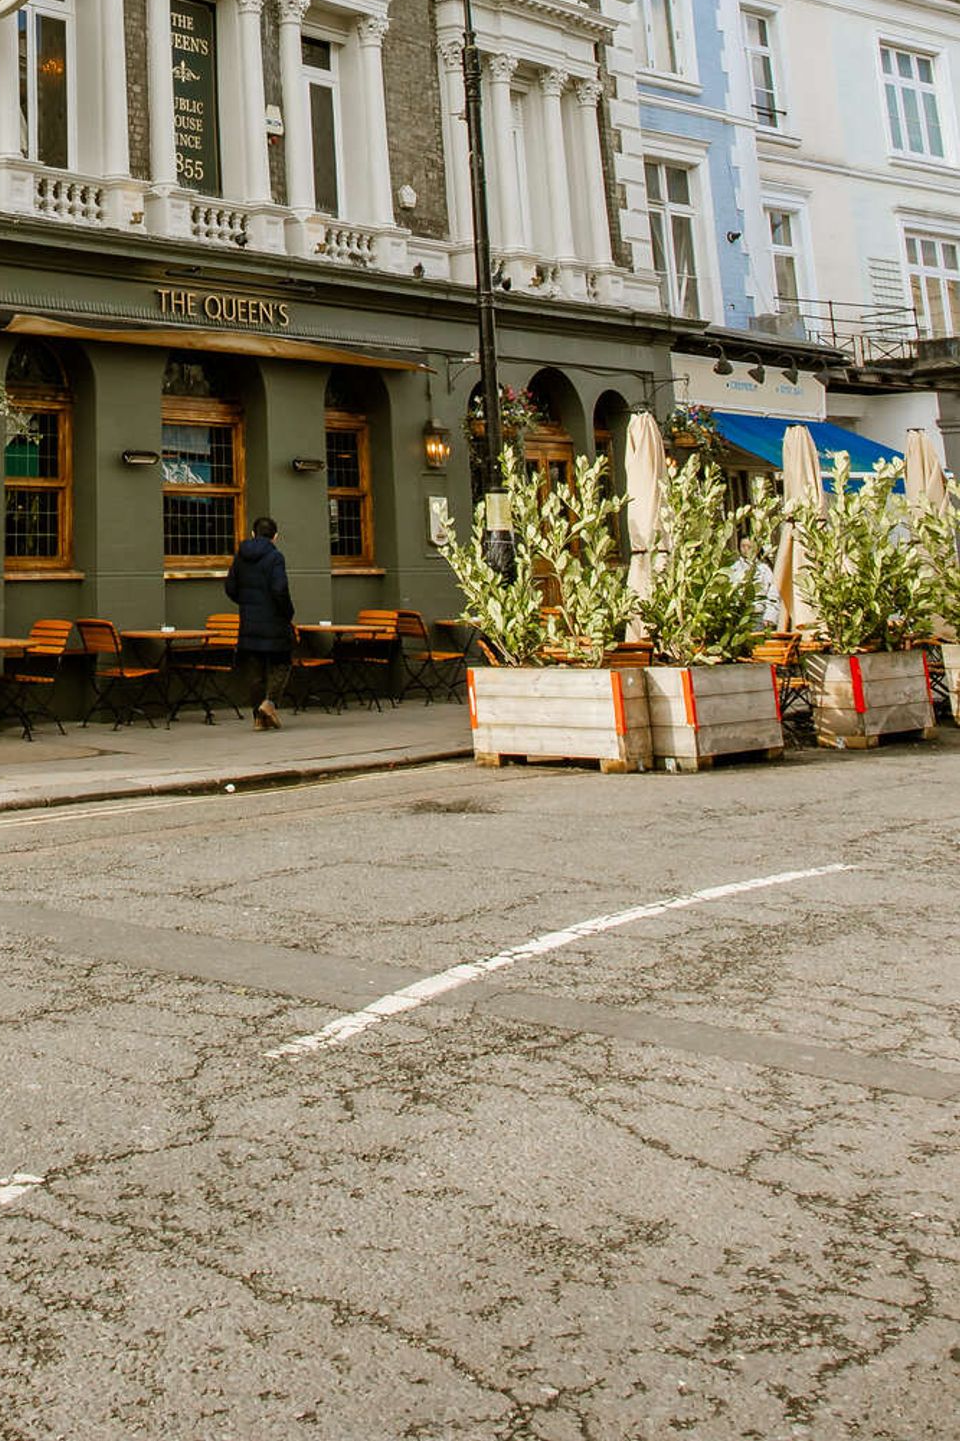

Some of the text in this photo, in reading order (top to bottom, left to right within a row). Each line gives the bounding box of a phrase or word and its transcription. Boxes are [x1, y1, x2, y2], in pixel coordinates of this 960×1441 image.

[170, 12, 194, 31] THE
[171, 32, 209, 56] EEN'S
[174, 96, 204, 115] UBLIC
[174, 114, 204, 132] OUSE
[175, 132, 203, 150] INCE
[176, 152, 204, 180] 855
[158, 289, 289, 327] THE QUEEN'S
